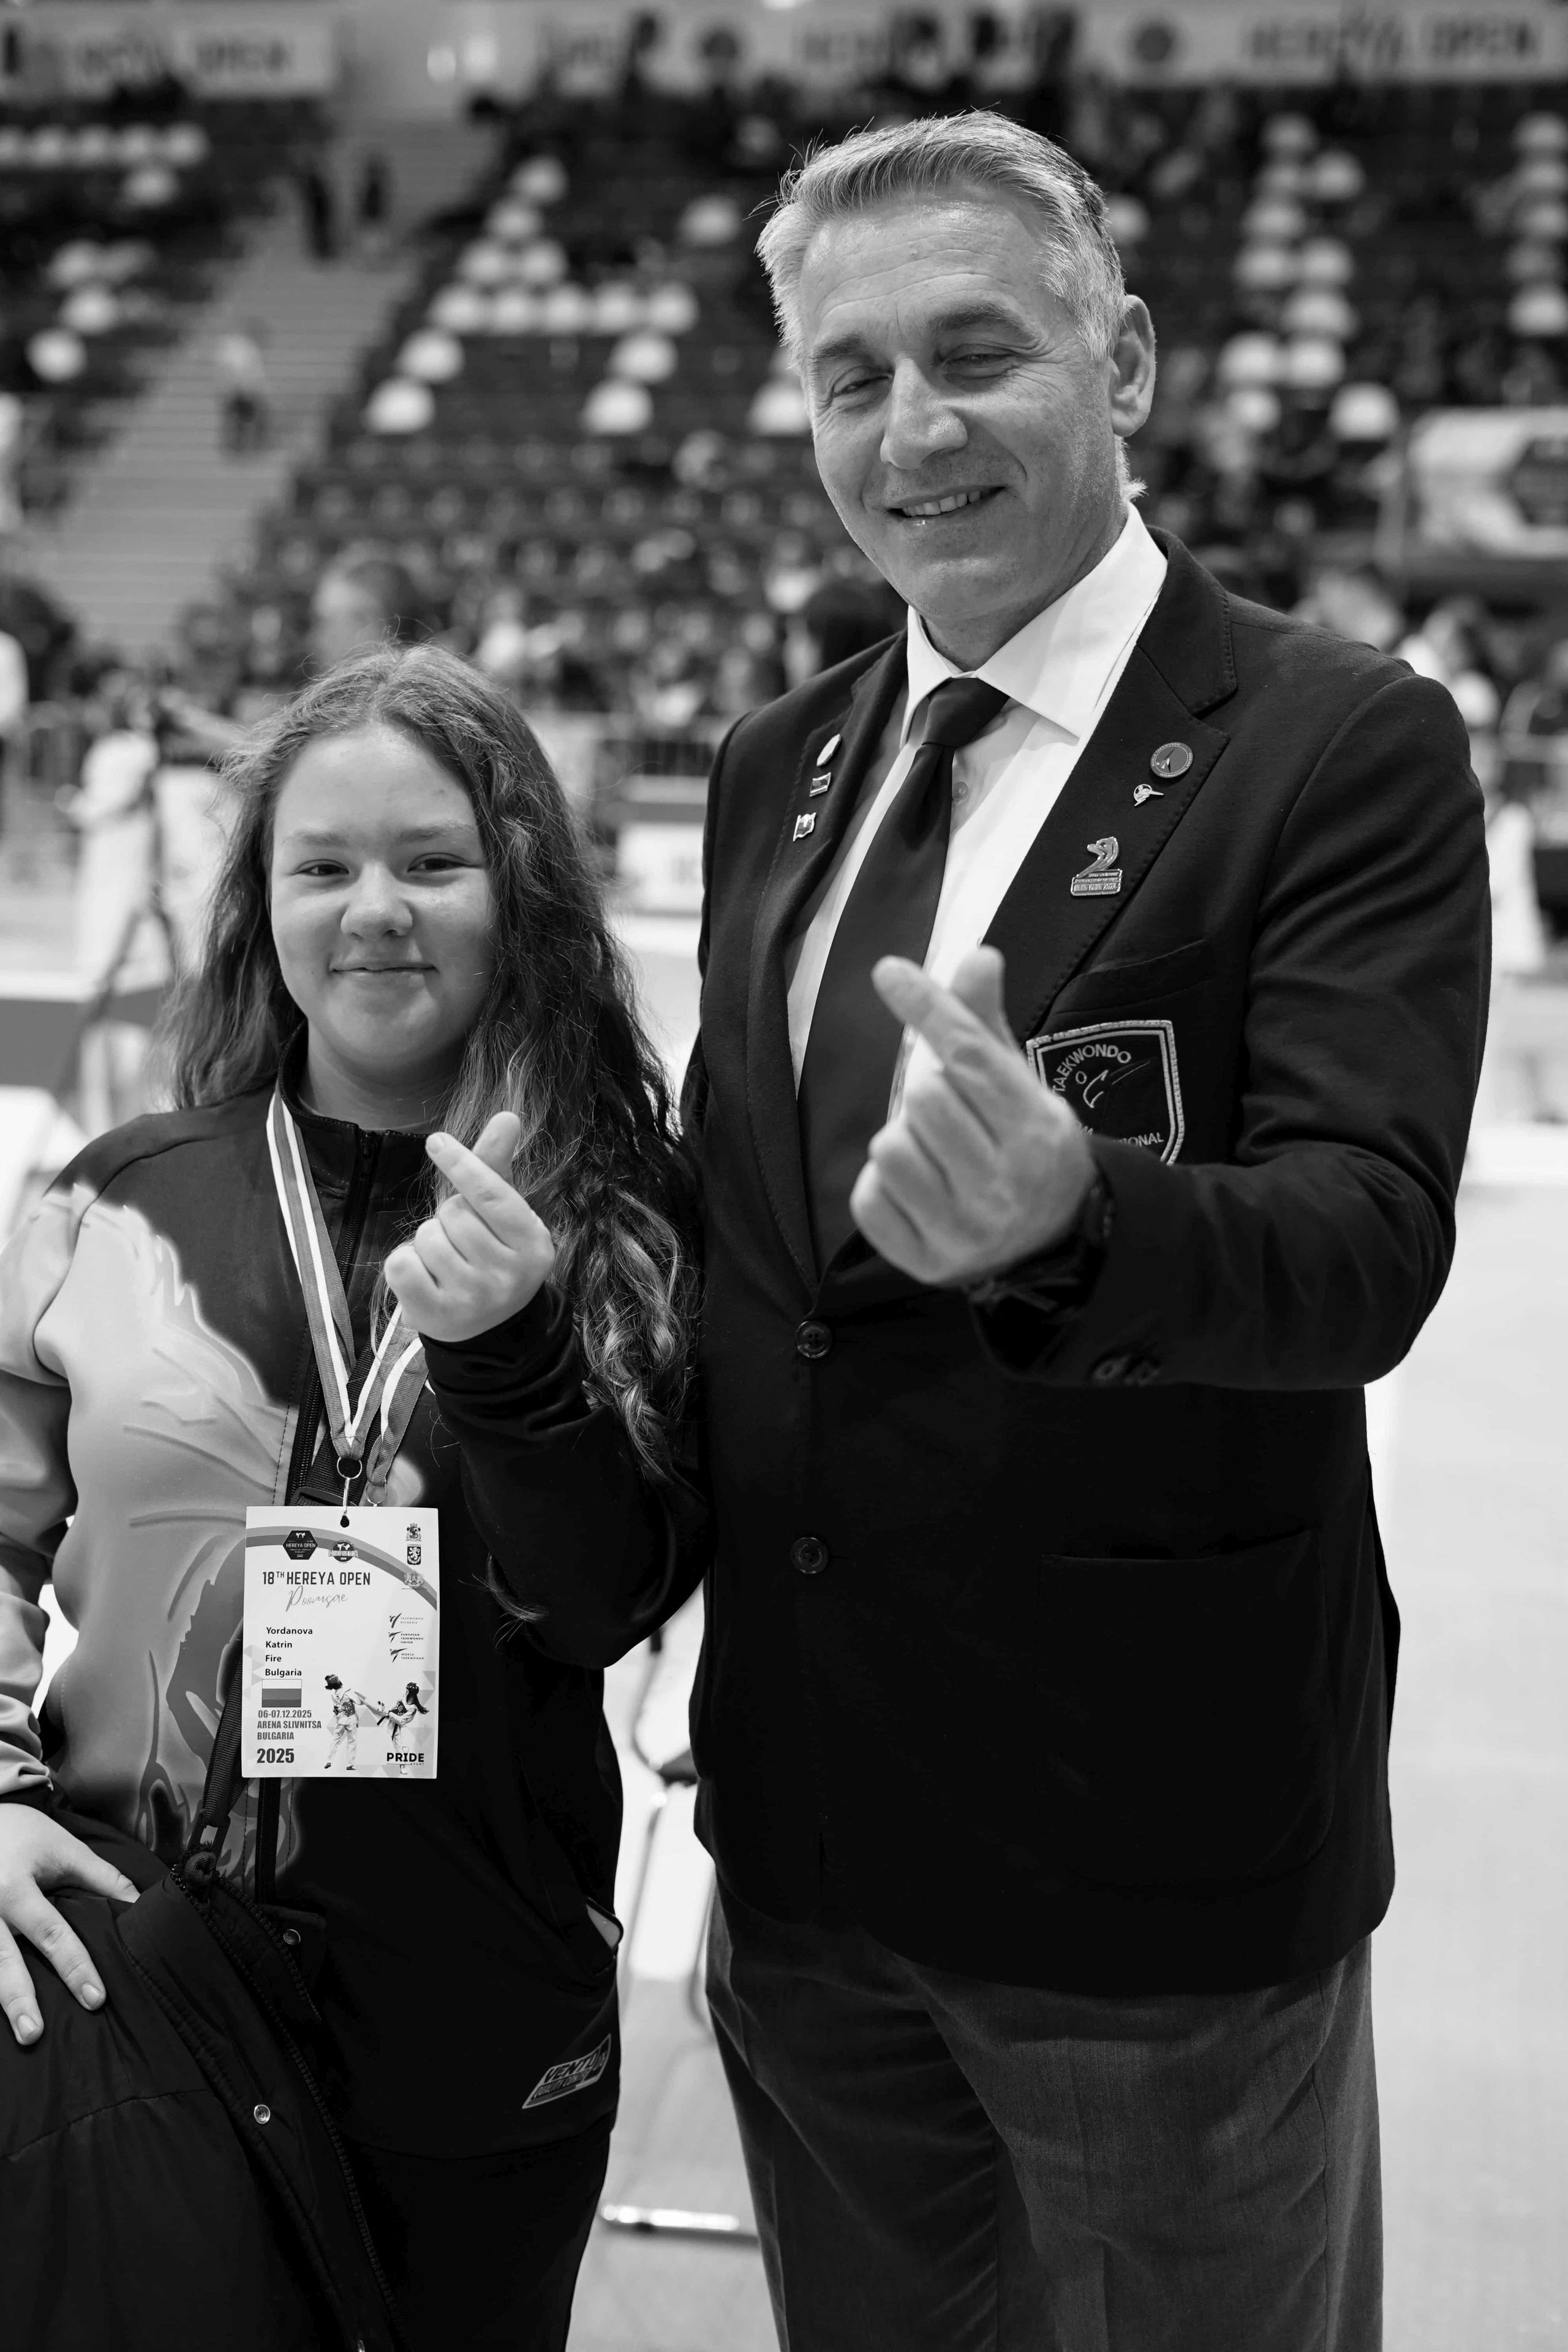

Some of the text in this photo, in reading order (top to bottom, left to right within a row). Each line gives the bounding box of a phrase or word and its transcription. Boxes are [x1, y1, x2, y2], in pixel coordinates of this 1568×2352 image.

[287, 1572, 335, 1585] HEREYA
[340, 1572, 371, 1585] OPEN
[265, 1668, 302, 1678] Bulgaria
[258, 1709, 312, 1718] 06-07.12.2025
[257, 1732, 294, 1740] BULGARIA
[257, 1748, 295, 1763] 2025
[386, 1752, 424, 1762] PRIDE
